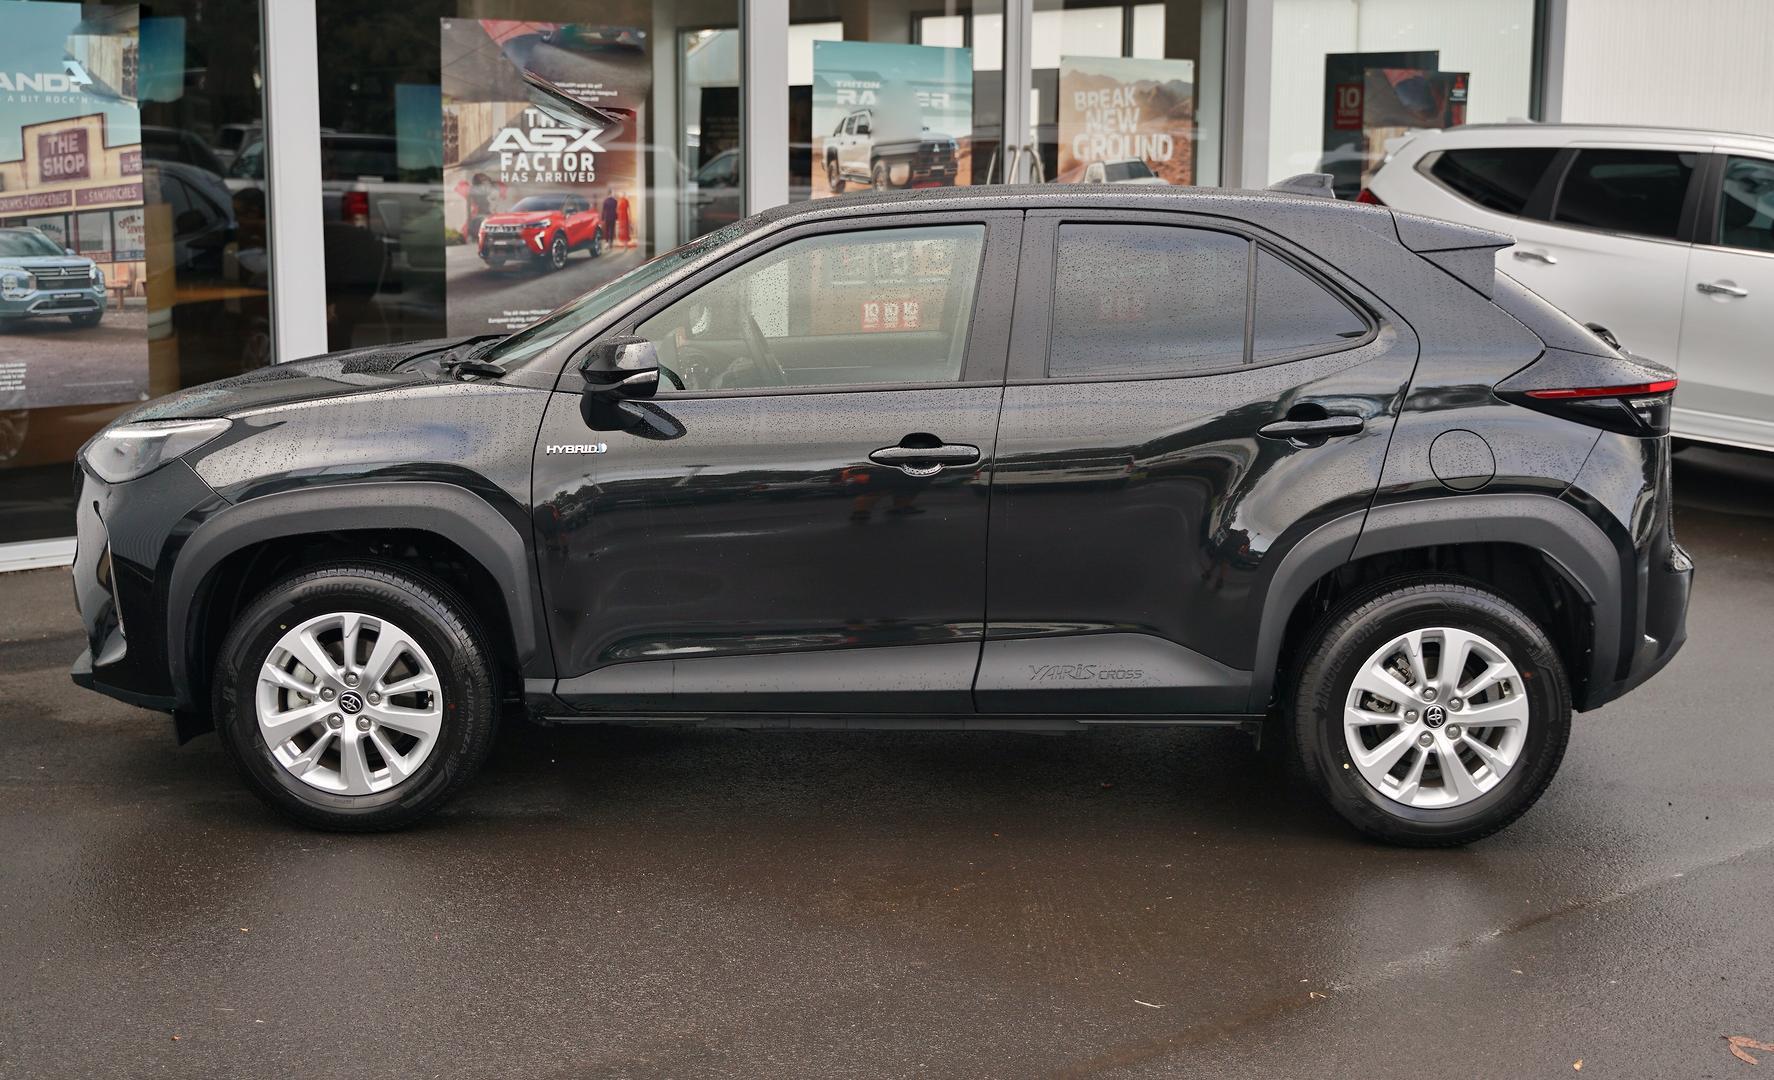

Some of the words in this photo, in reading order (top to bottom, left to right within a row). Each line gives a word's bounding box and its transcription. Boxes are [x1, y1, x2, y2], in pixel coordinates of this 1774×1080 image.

[7, 95, 14, 103] A
[20, 95, 39, 103] BIT
[1074, 86, 1137, 112] BREAK
[1086, 107, 1140, 133] NEW
[47, 132, 80, 155] THE
[488, 127, 607, 152] ASX
[1072, 133, 1174, 162] GROUND
[43, 153, 86, 177] SHOP
[500, 152, 595, 172] FACTOR
[501, 172, 529, 183] HAS
[535, 172, 596, 183] ARRIVED
[546, 445, 598, 455] HYBRID
[1098, 669, 1143, 680] CROSS
